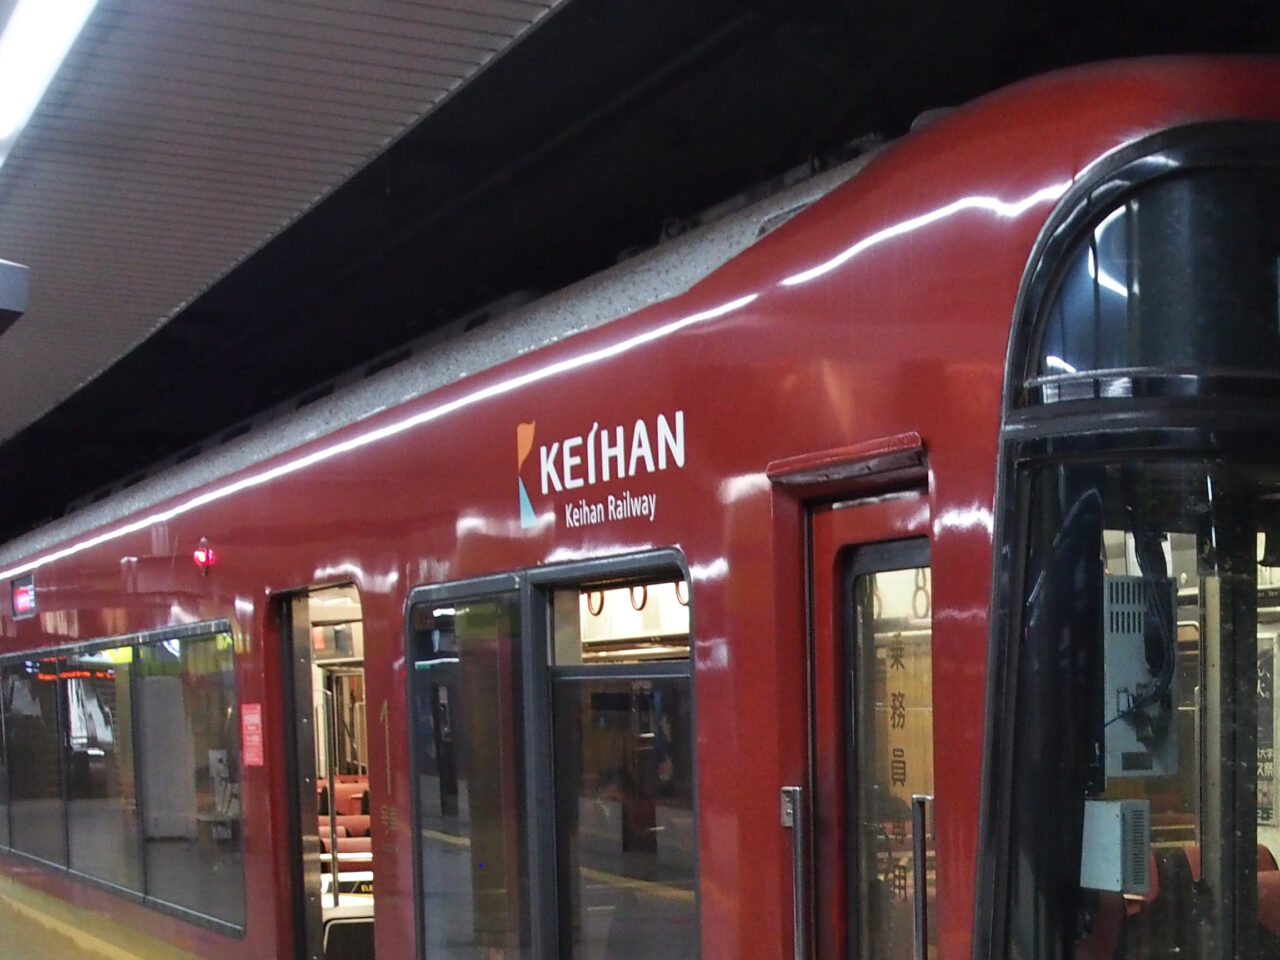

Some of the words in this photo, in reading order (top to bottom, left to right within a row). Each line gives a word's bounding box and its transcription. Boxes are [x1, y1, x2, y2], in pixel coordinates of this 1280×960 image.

[540, 410, 685, 495] KEIHAN
[565, 499, 605, 528] Keihan
[607, 490, 656, 522] Railway
